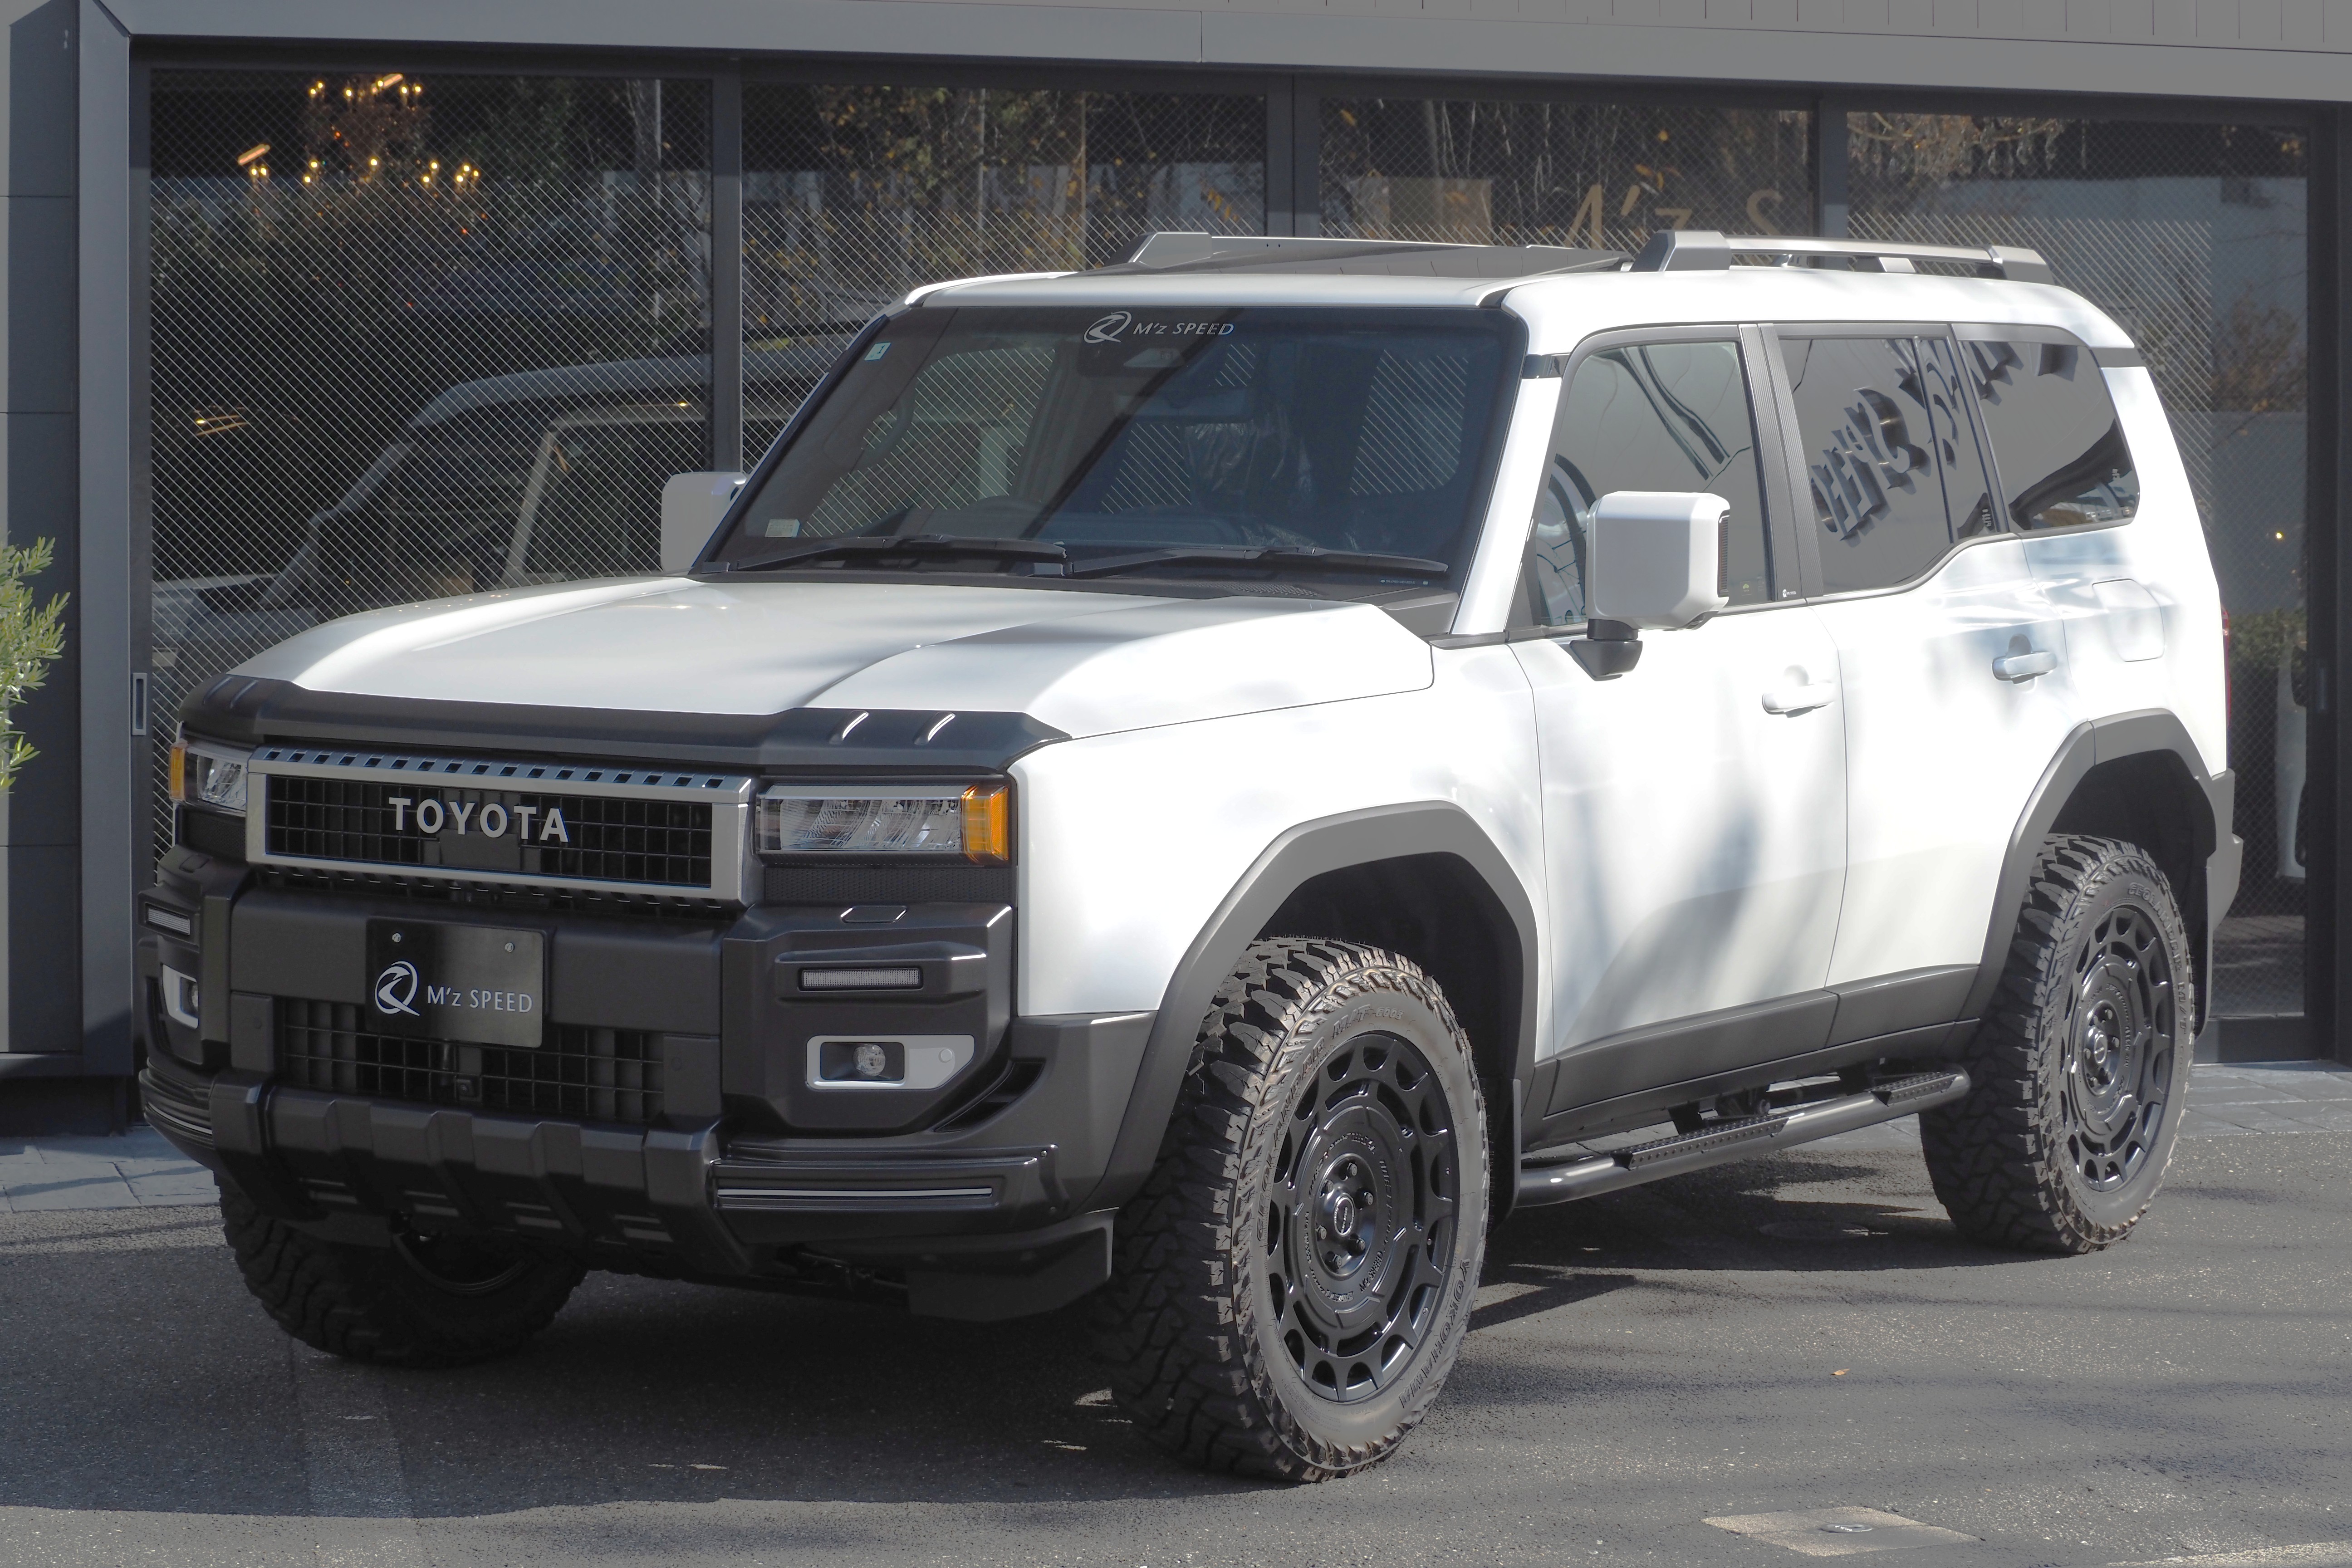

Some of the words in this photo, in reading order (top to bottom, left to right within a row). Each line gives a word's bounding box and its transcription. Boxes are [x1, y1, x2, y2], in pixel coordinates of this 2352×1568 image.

[1132, 323, 1168, 335] M'z
[1172, 323, 1235, 336] SPEED
[388, 796, 569, 843] TOYOTA
[427, 985, 462, 1007] M'z
[469, 989, 533, 1013] SPEED
[1398, 1258, 1470, 1409] YOKOHAMA
